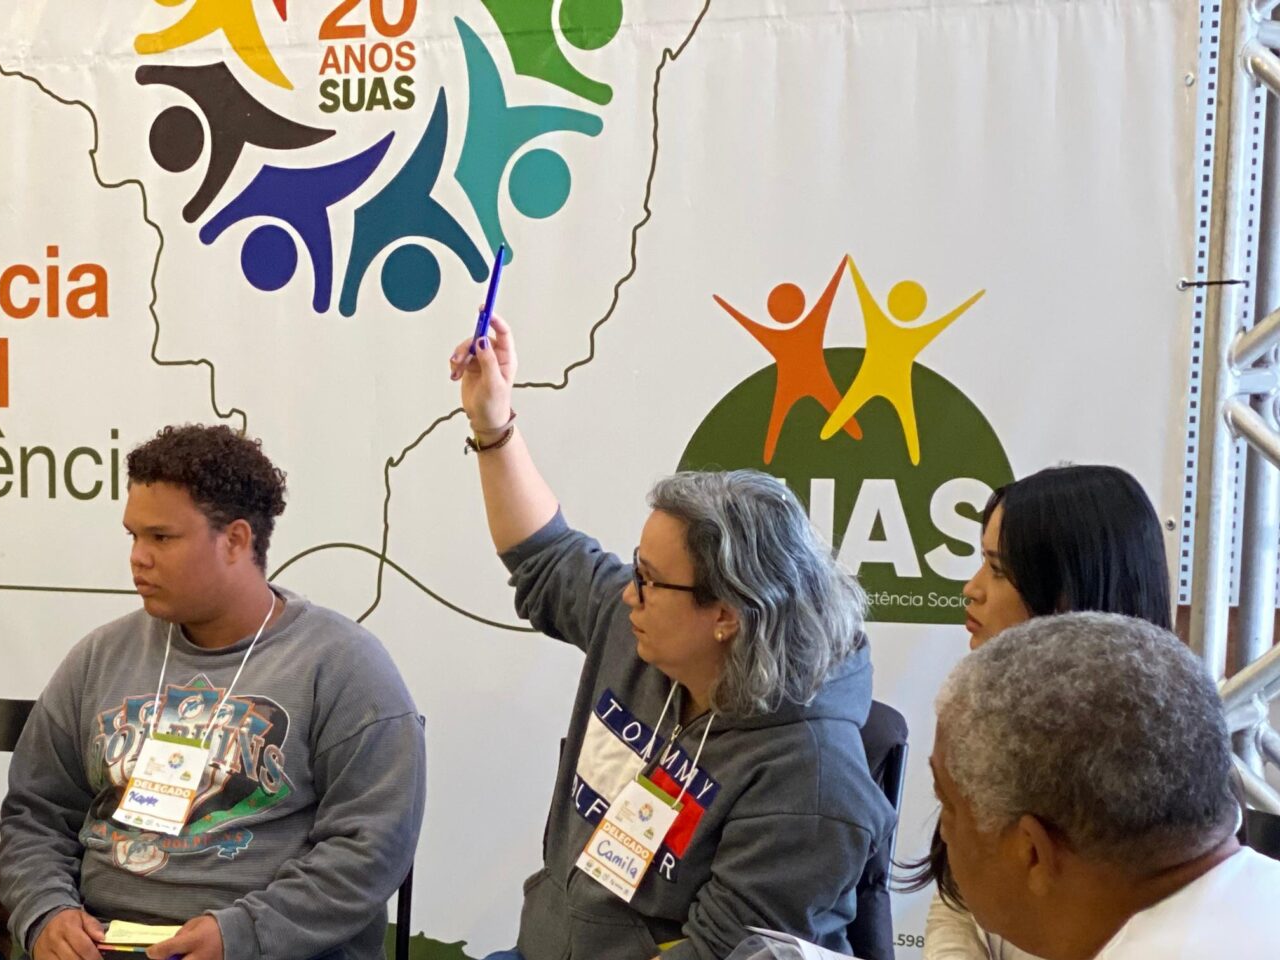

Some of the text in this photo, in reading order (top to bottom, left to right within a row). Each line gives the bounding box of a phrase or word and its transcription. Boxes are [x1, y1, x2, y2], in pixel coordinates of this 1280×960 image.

[318, 40, 416, 76] ANOS
[318, 75, 416, 114] SUAS
[776, 476, 995, 582] AS
[867, 591, 971, 608] stência Soci
[132, 779, 192, 800] DELEGADO
[596, 839, 639, 880] Camila
[602, 821, 651, 860] DELEGADO
